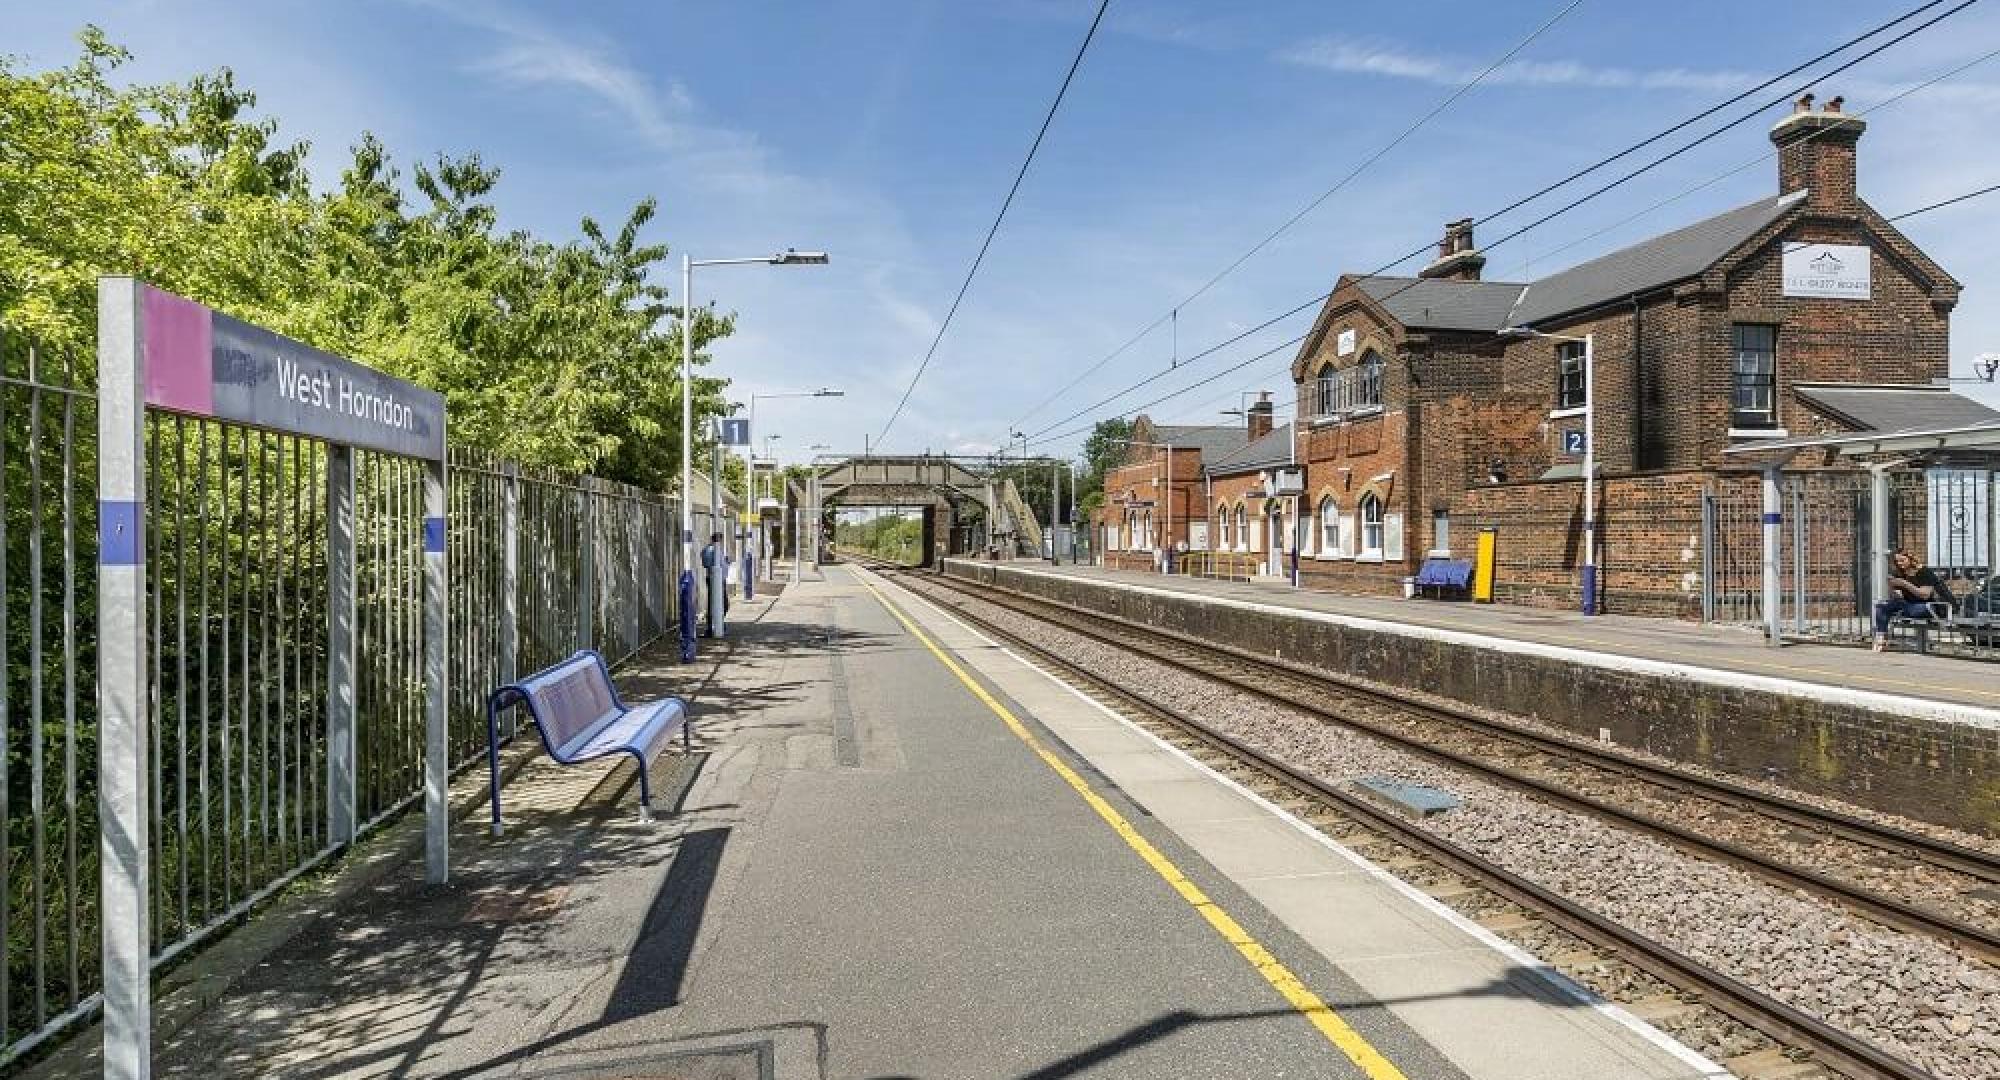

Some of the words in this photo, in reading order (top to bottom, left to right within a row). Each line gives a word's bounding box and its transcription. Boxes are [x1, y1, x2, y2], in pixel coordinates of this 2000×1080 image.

[277, 356, 331, 409] West
[339, 376, 413, 431] Horndon
[730, 422, 739, 444] 1
[1569, 433, 1581, 451] 2
